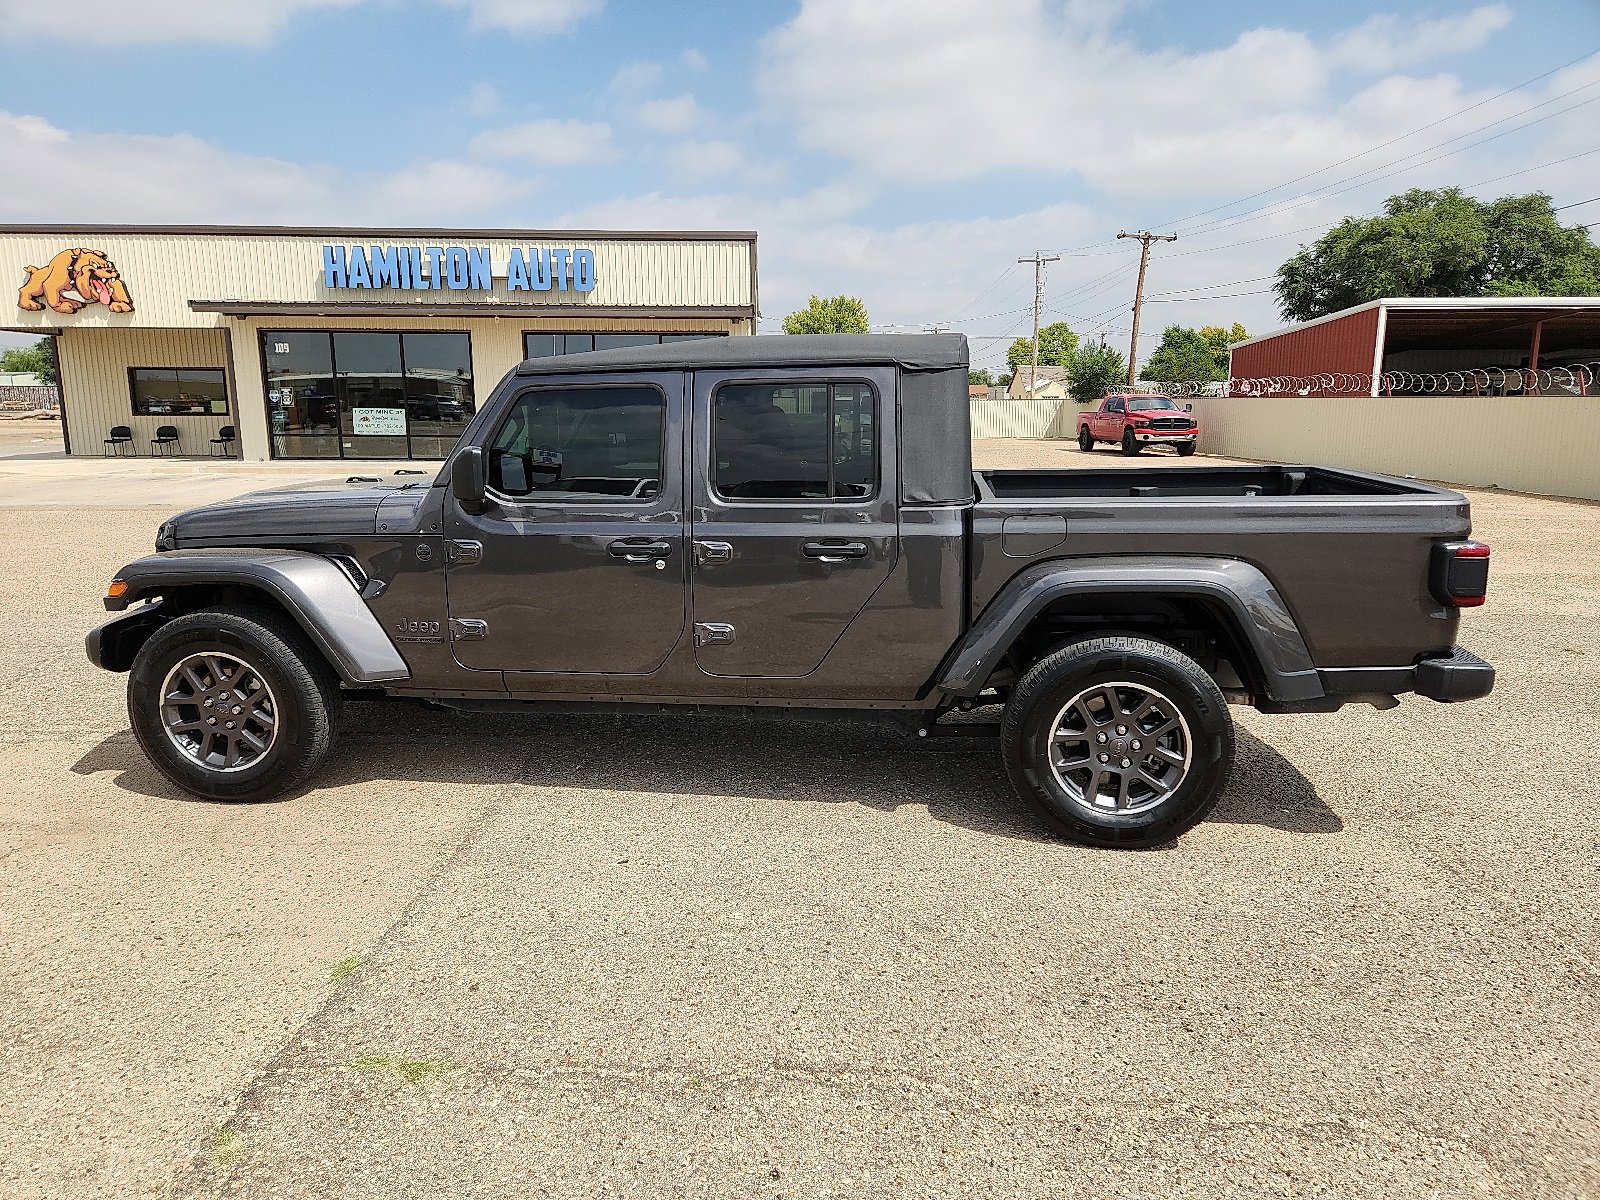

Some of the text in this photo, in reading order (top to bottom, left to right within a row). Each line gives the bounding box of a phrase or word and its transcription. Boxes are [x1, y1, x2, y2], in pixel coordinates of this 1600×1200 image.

[323, 245, 596, 291] HAMILTON AUTO
[274, 342, 290, 353] 109
[395, 616, 441, 636] Jeep
